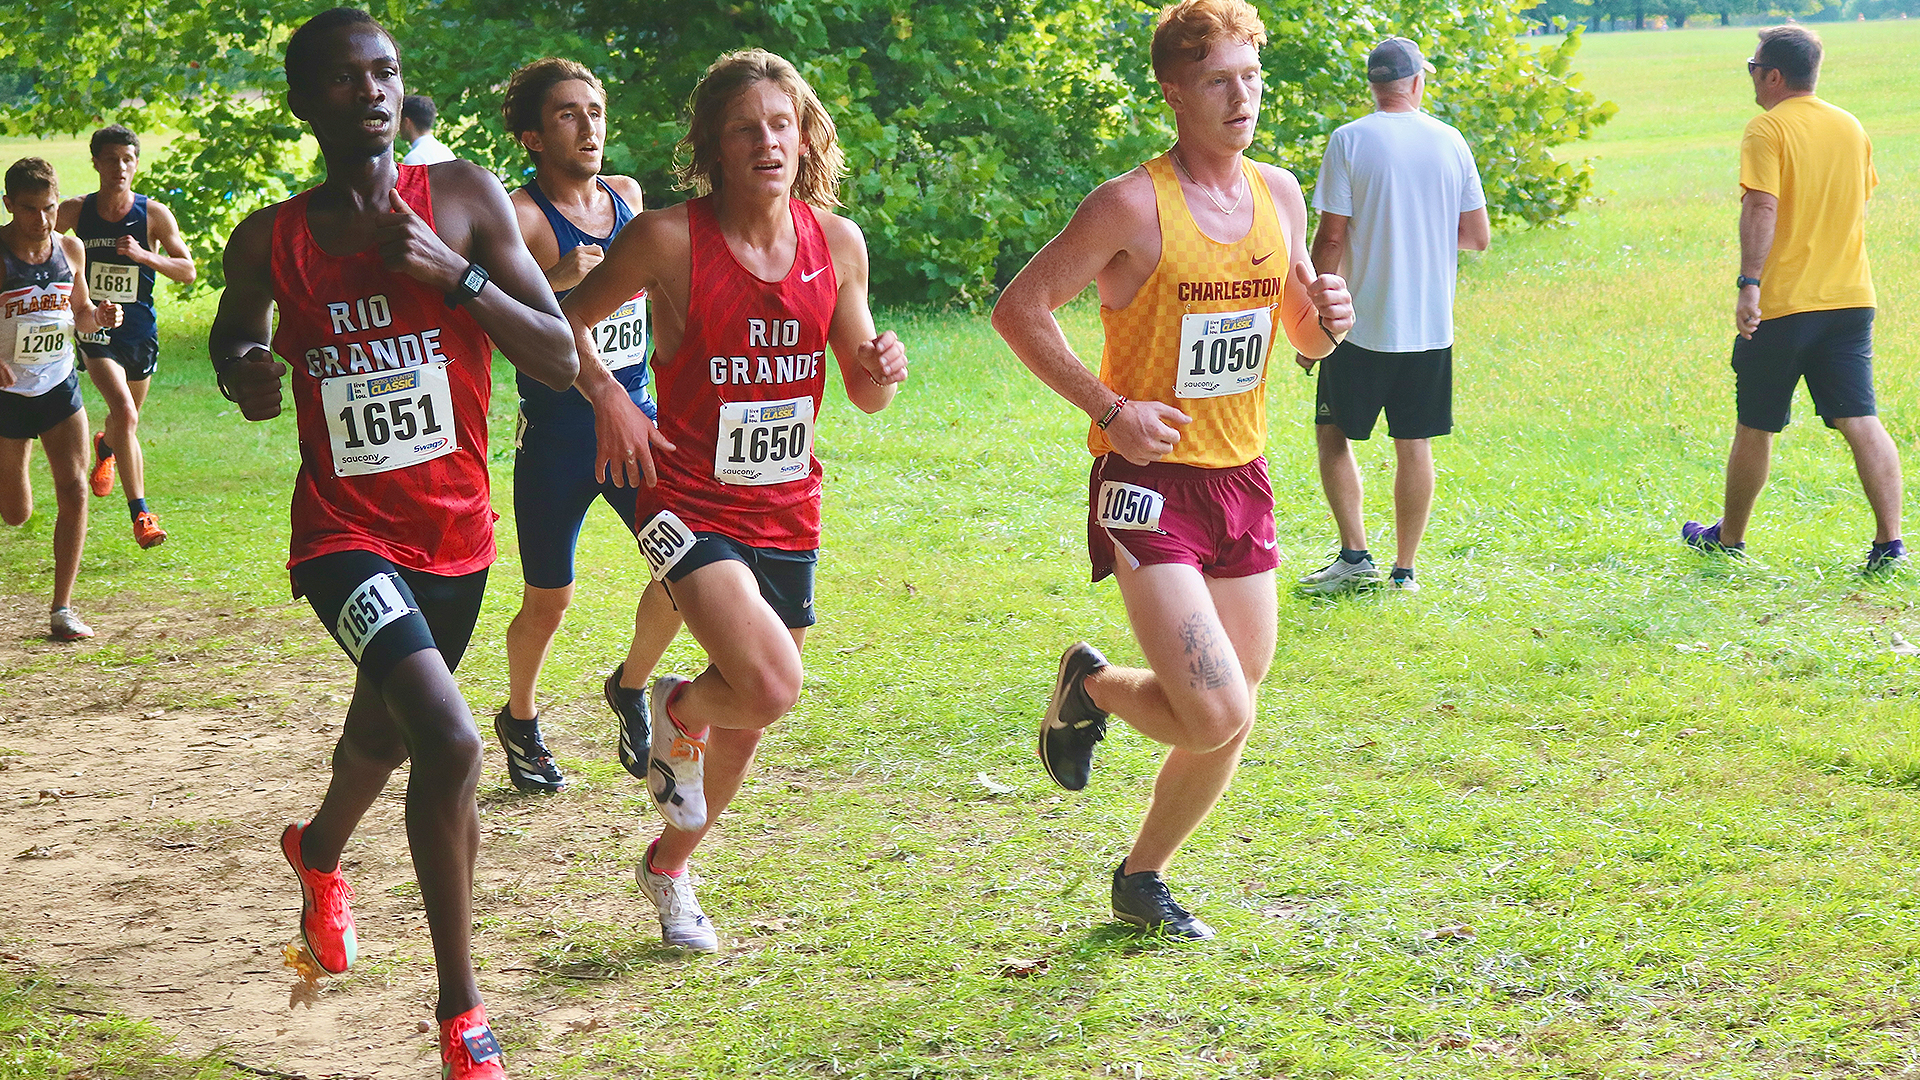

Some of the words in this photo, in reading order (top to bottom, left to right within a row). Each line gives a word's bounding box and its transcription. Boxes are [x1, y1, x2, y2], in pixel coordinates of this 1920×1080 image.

[95, 274, 132, 293] 1681
[1178, 277, 1280, 301] CHARLESTON
[327, 294, 393, 335] RIO
[747, 318, 800, 347] RIO
[1222, 319, 1253, 332] CLASSIC
[21, 333, 64, 353] 1208
[305, 328, 448, 378] GRANDE
[1189, 334, 1263, 376] 1050
[709, 351, 824, 385] GRANDE
[371, 378, 415, 395] CLASSIC
[389, 373, 415, 383] COUNTRY
[1184, 380, 1214, 388] saucony
[1236, 374, 1256, 384] Swags
[339, 394, 442, 449] 1651
[762, 408, 795, 421] CLASSIC
[413, 439, 443, 453] Swags
[728, 422, 806, 463] 1650
[341, 453, 380, 464] saucony
[722, 468, 756, 477] saucony
[780, 464, 801, 473] Swags
[1102, 487, 1153, 525] 1050
[342, 584, 394, 648] 1651
